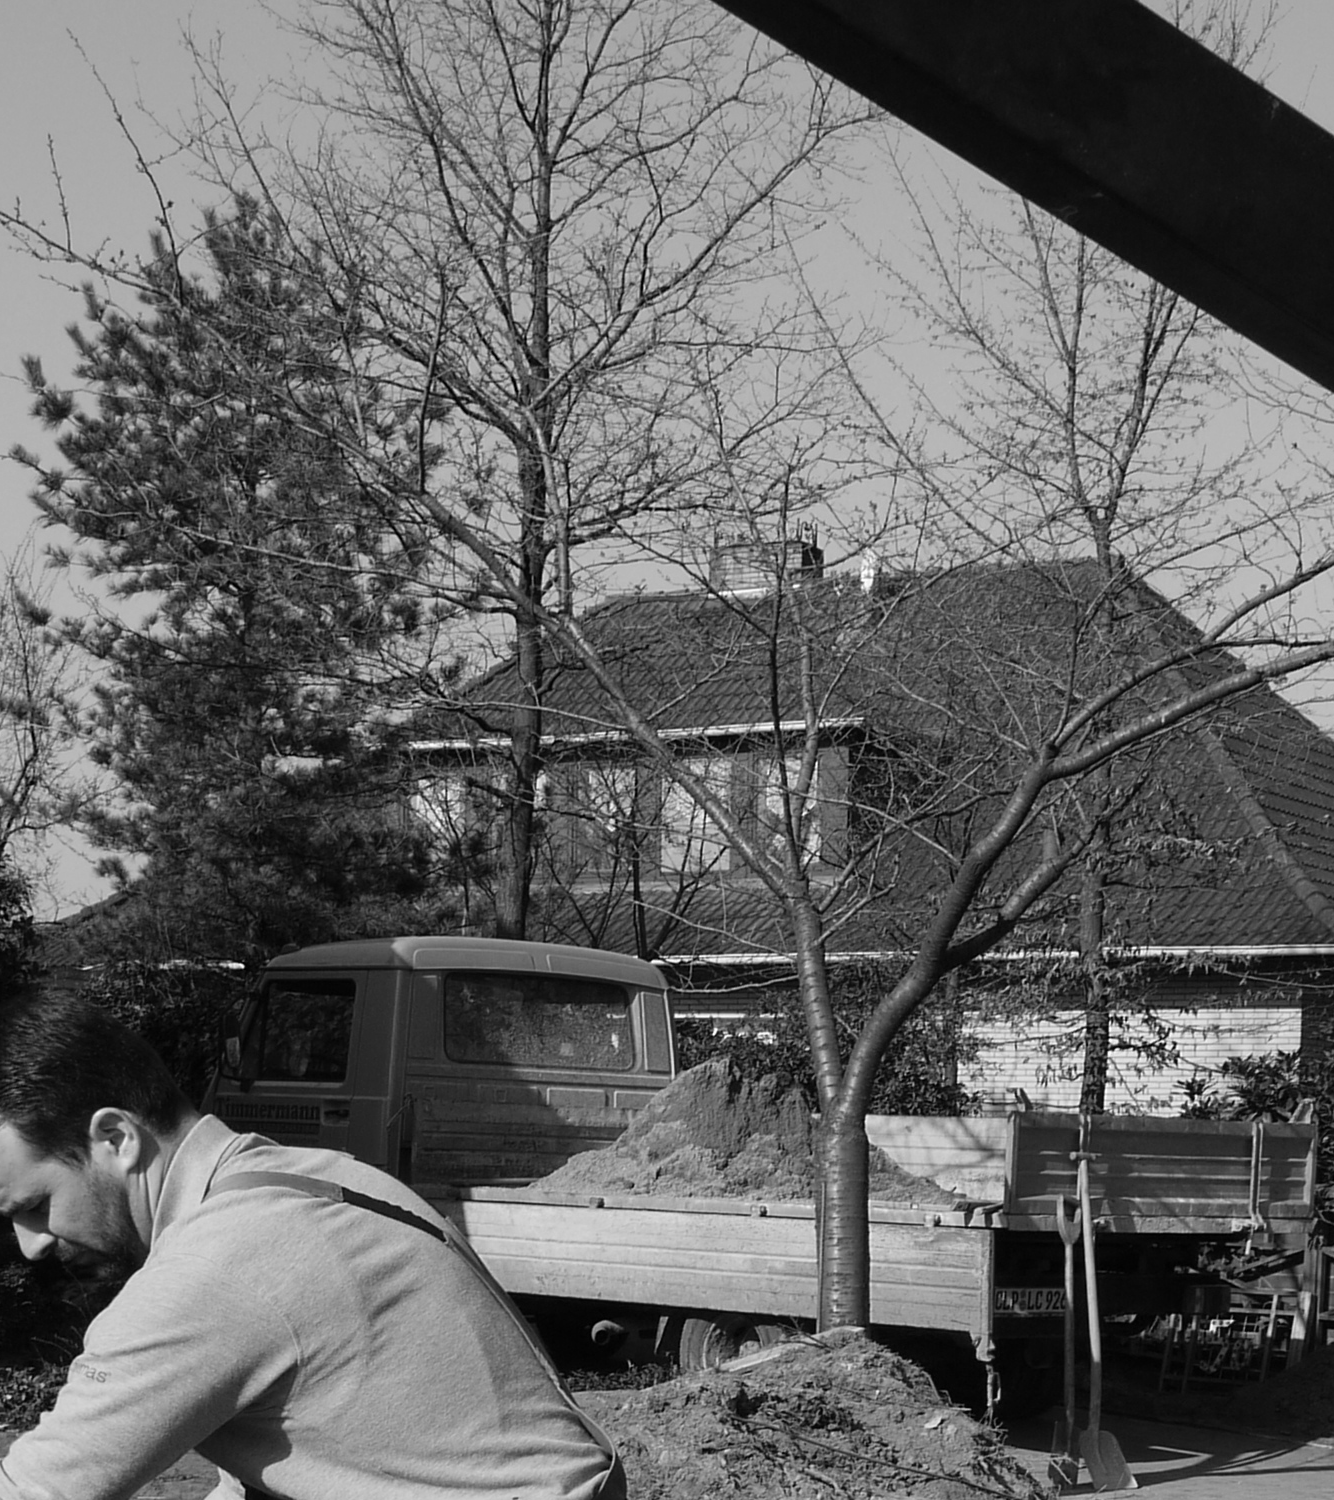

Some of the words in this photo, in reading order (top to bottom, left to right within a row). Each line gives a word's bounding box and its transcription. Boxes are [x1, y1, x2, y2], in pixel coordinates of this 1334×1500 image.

[214, 1097, 320, 1121] Timmermann
[995, 1290, 1019, 1310] CLP
[1027, 1290, 1043, 1310] LC
